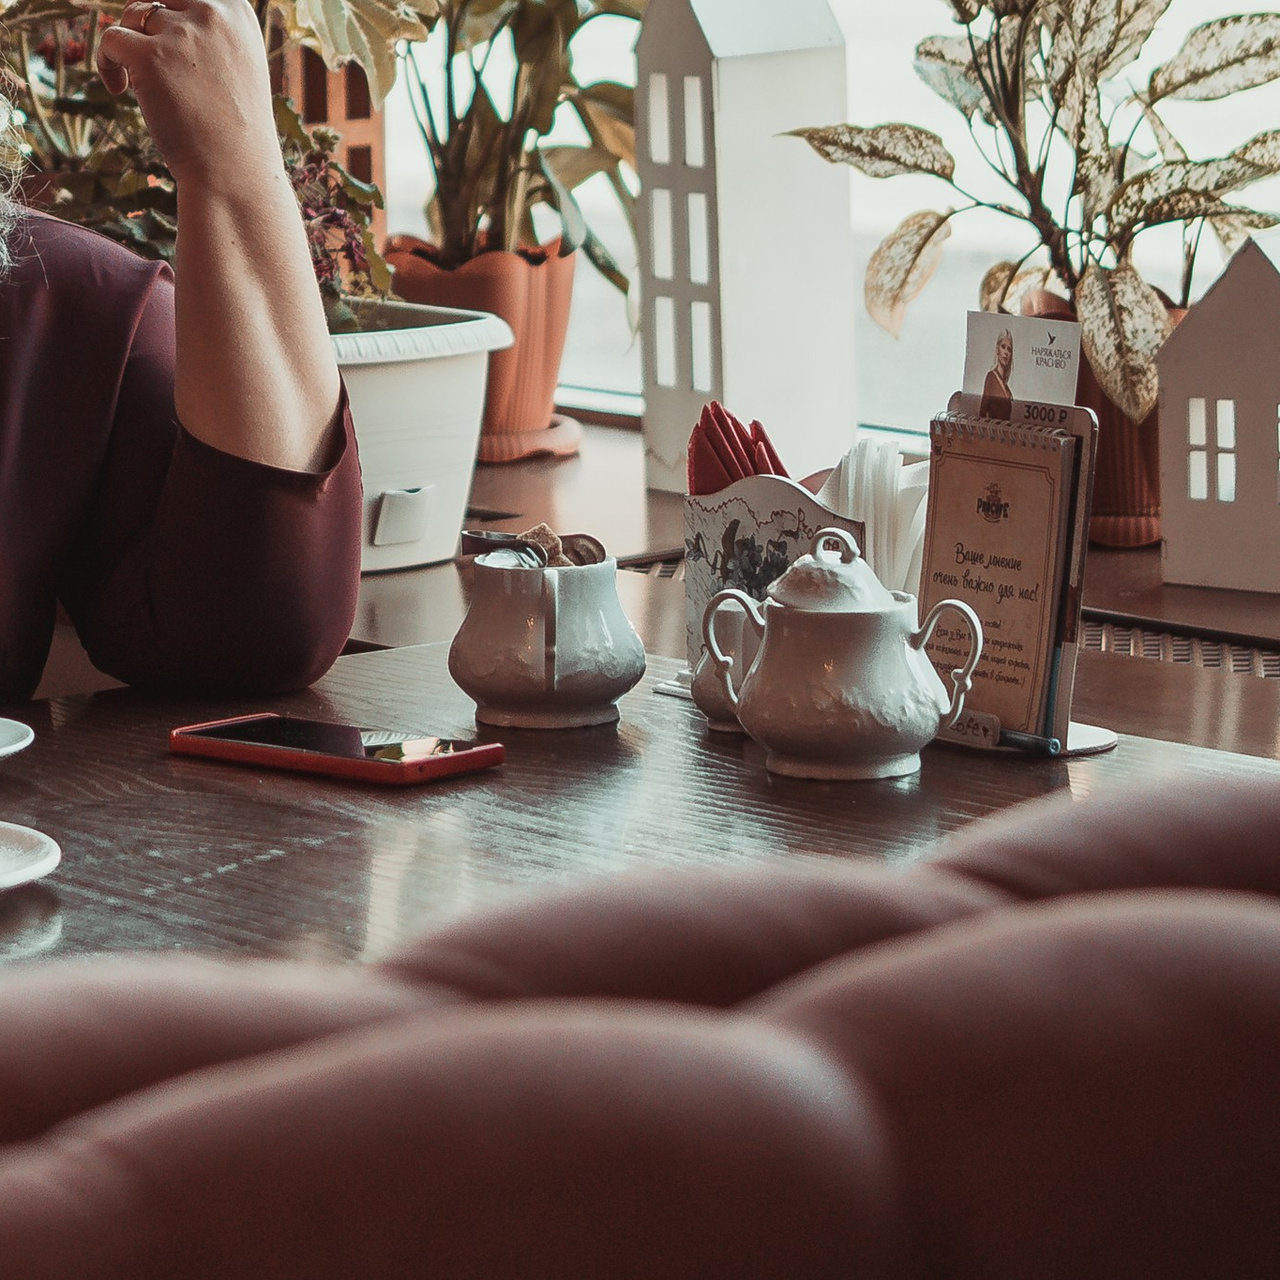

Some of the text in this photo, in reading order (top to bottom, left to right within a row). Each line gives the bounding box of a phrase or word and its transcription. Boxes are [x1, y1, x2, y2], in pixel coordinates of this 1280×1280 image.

[1024, 404, 1055, 423] 3000
[954, 542, 1022, 571] Ваше мнение
[933, 568, 1040, 605] очень важно для нас!
